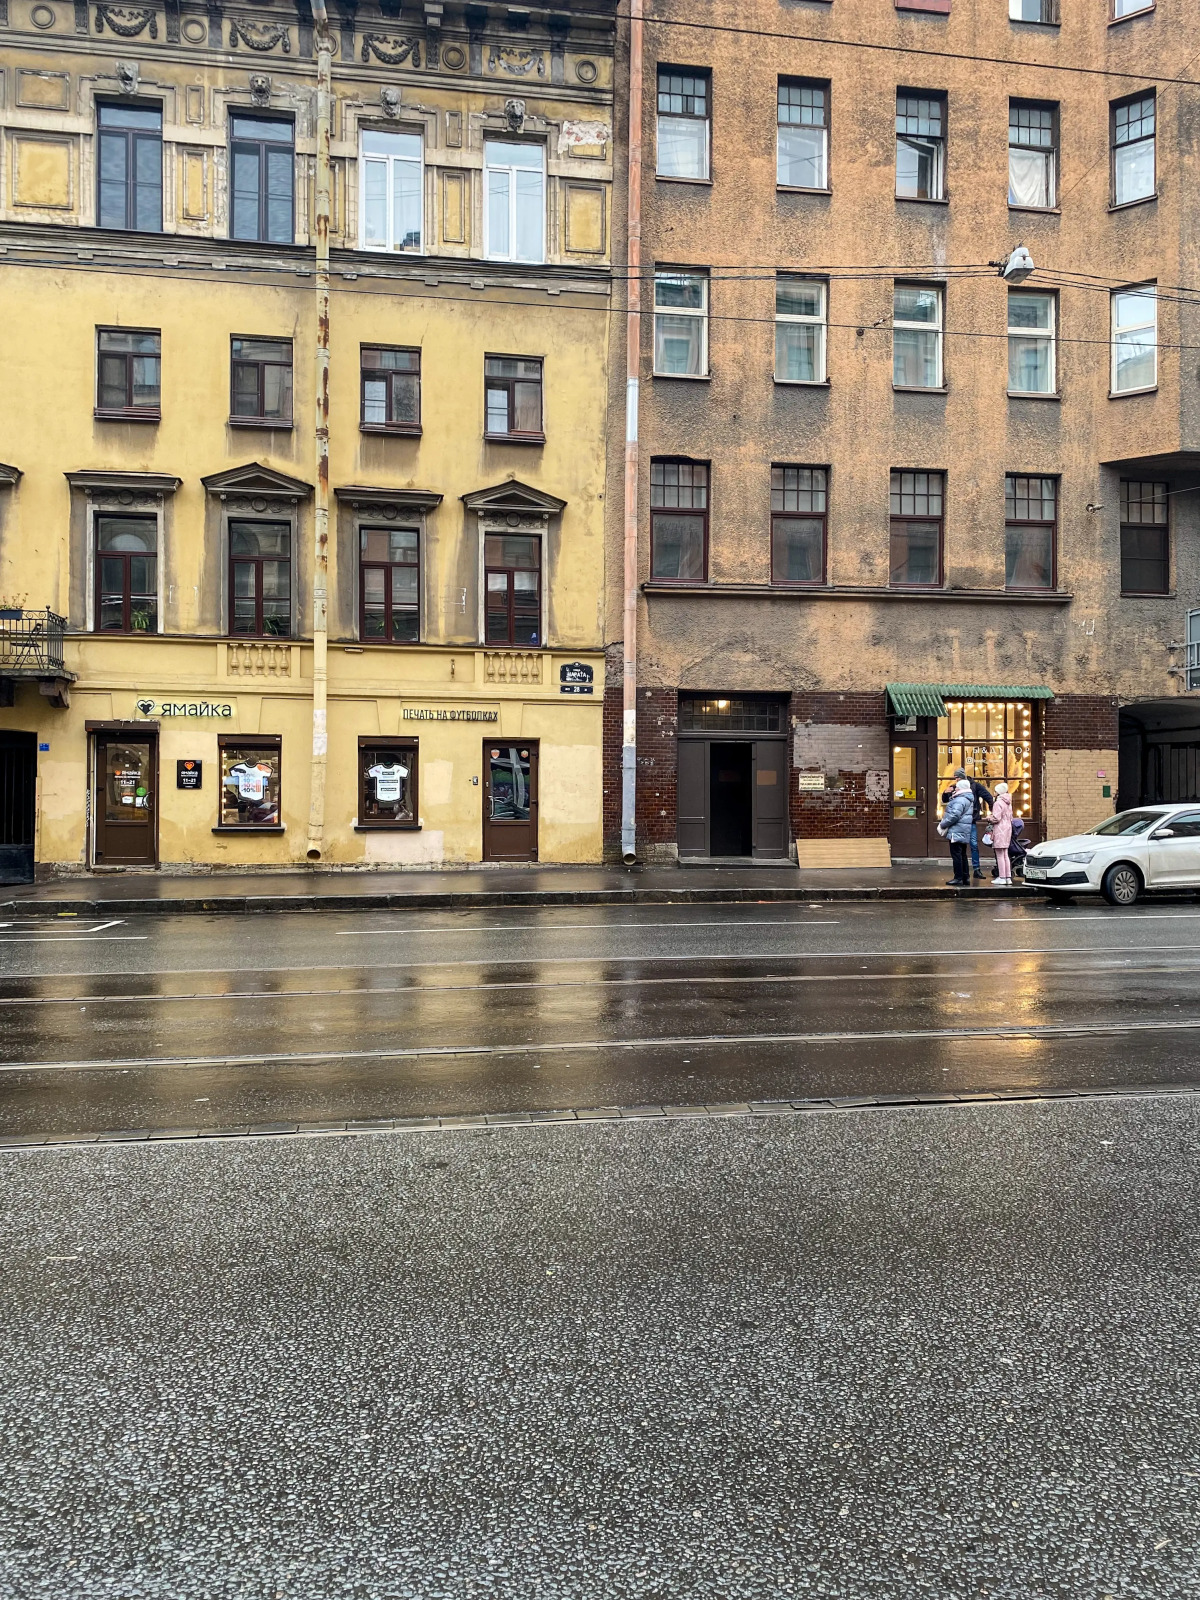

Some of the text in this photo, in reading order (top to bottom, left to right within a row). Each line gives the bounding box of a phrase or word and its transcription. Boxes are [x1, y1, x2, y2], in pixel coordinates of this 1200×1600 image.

[402, 708, 498, 721] ПЕЧАТЬ НА ФУТБОЛКАХ
